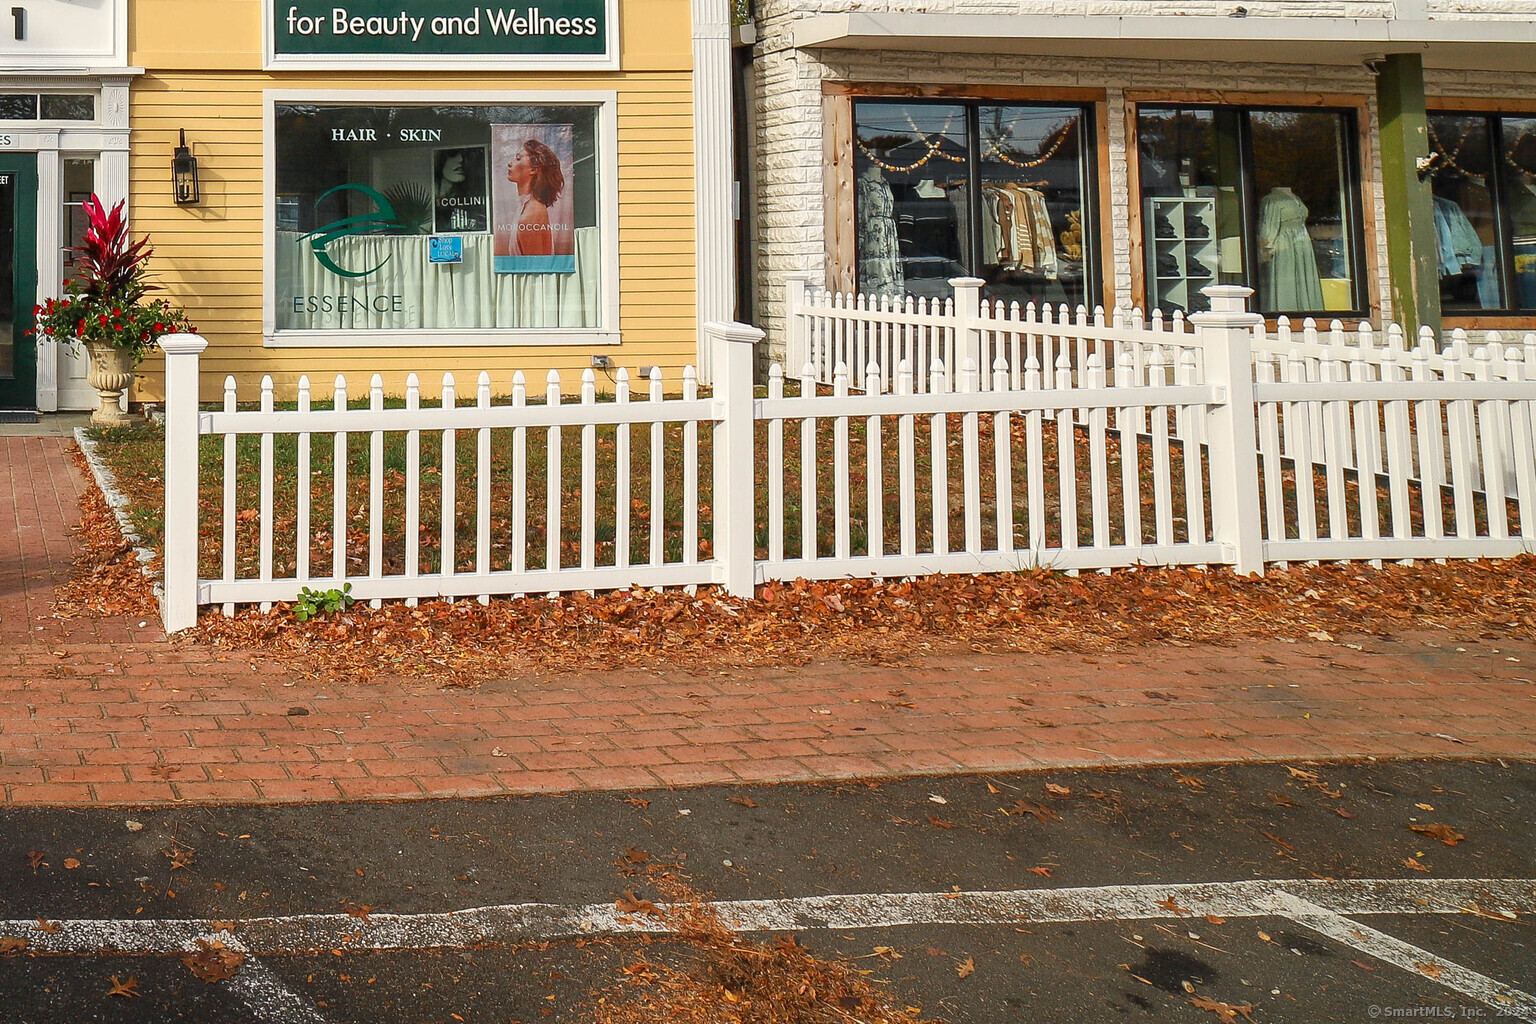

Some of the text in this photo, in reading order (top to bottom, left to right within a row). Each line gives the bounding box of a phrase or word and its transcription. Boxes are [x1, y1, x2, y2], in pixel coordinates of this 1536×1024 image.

[287, 6, 597, 42] for Beauty and Wellness
[331, 128, 442, 142] HAIR SKIN
[441, 196, 481, 207] COLLIN
[497, 223, 570, 231] MOROCCANOIL
[293, 295, 402, 313] ESSENCE
